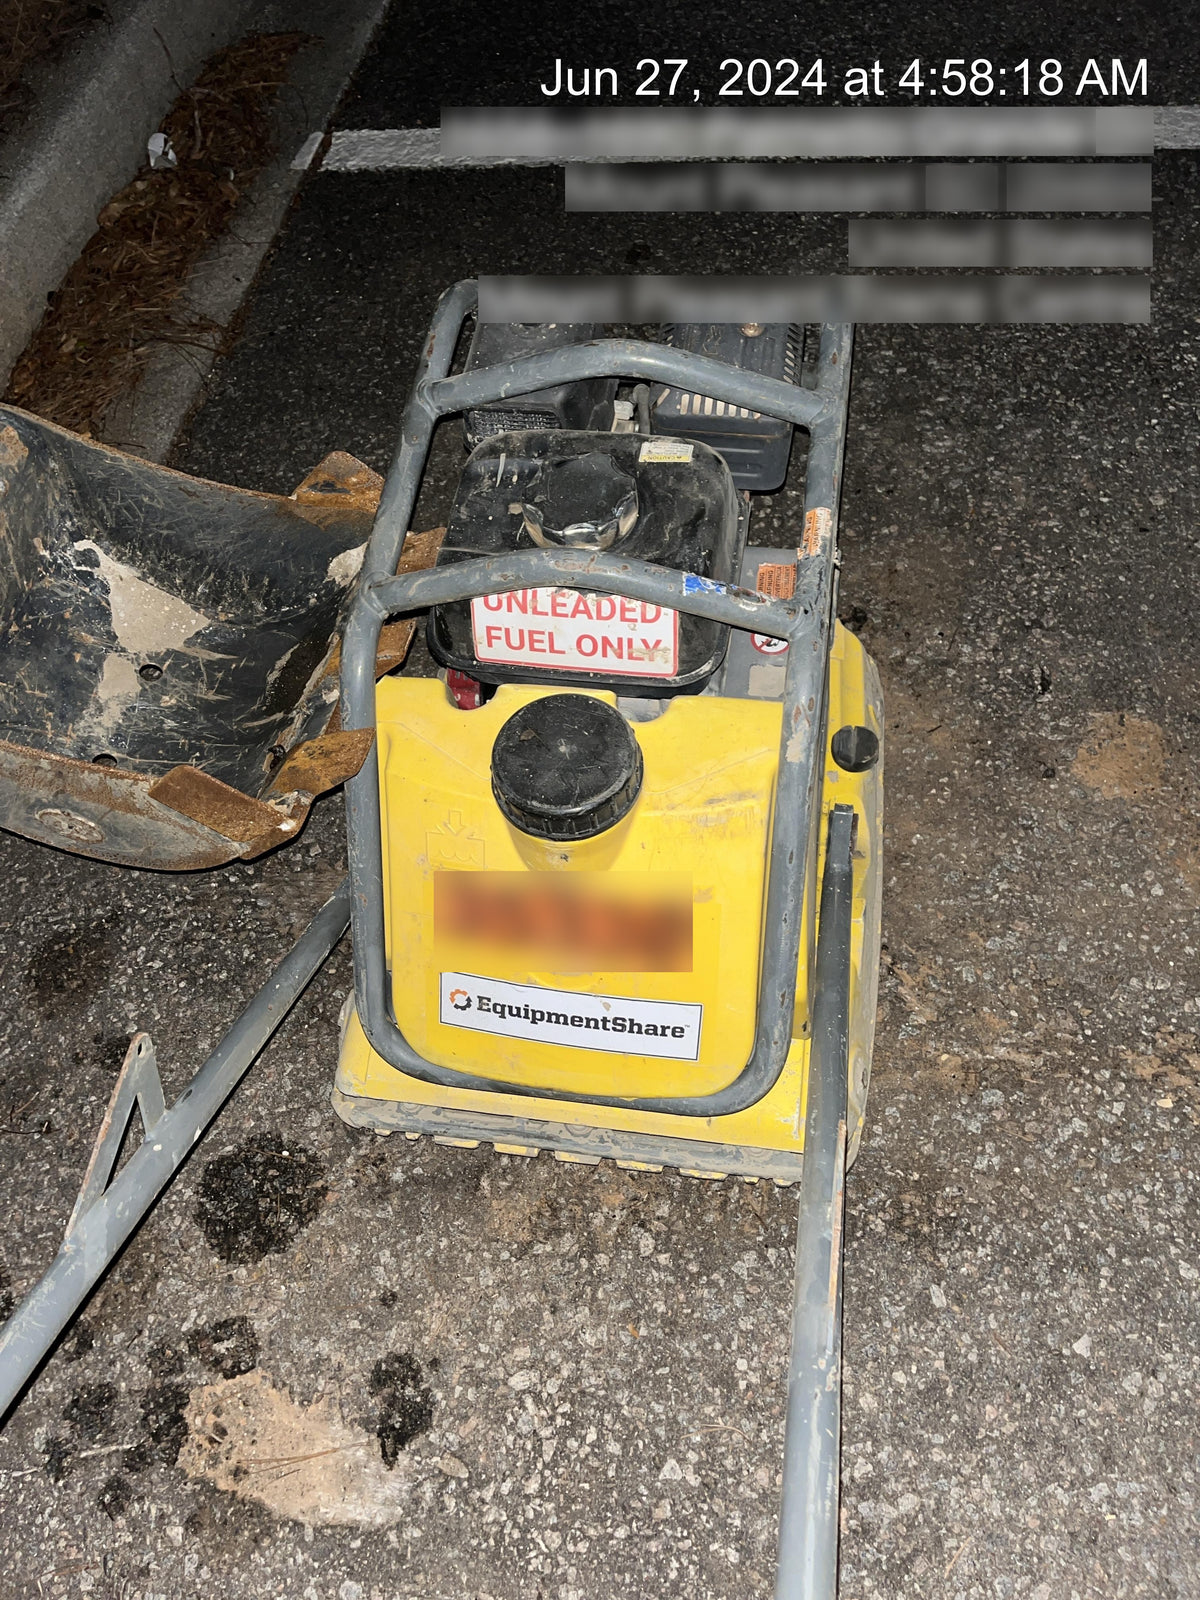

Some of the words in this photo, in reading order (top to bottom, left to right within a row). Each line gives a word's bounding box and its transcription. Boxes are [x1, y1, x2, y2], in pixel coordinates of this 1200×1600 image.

[766, 570, 774, 595] ARNUNG
[482, 587, 662, 624] UNLEADED
[485, 625, 566, 655] FUEL
[575, 633, 663, 662] ONLY
[476, 995, 686, 1039] EquipmentShare
